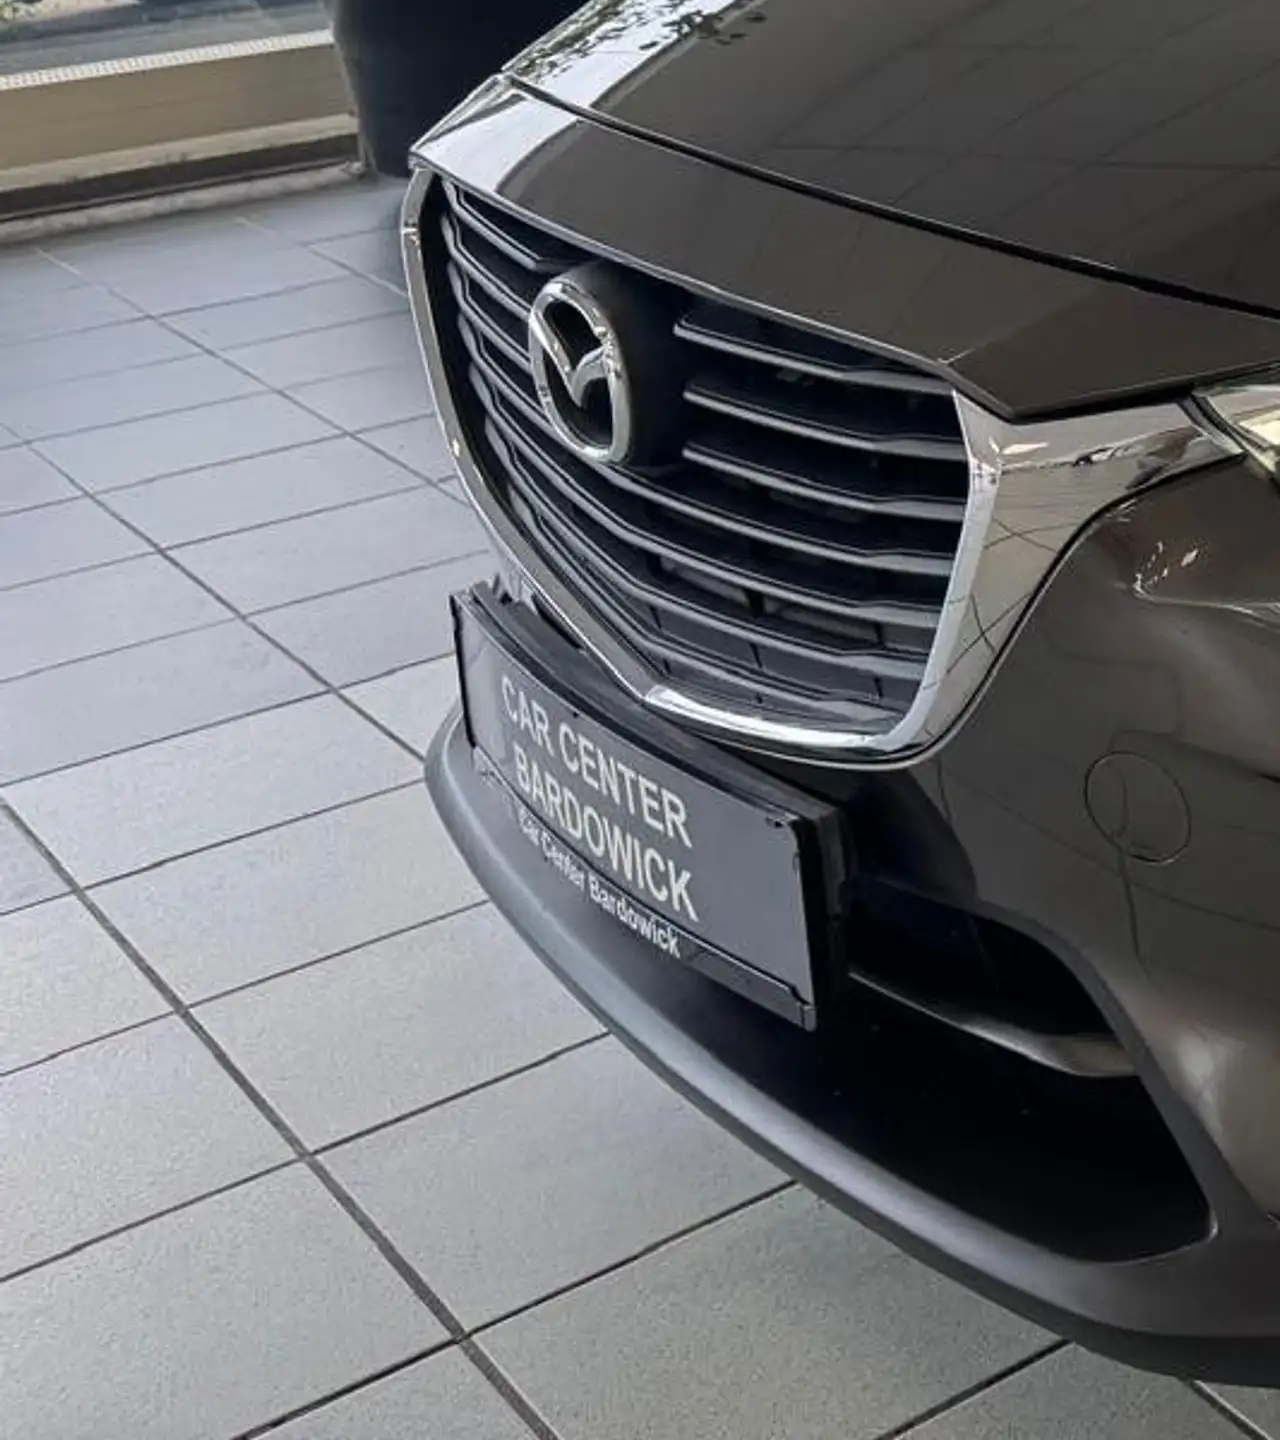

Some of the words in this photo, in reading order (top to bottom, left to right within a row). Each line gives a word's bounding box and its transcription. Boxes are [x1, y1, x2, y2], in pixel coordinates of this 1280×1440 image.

[502, 675, 555, 757] CAR
[558, 721, 693, 848] CENTER
[513, 740, 699, 922] BARDOWICK
[587, 871, 681, 959] Bardowick
